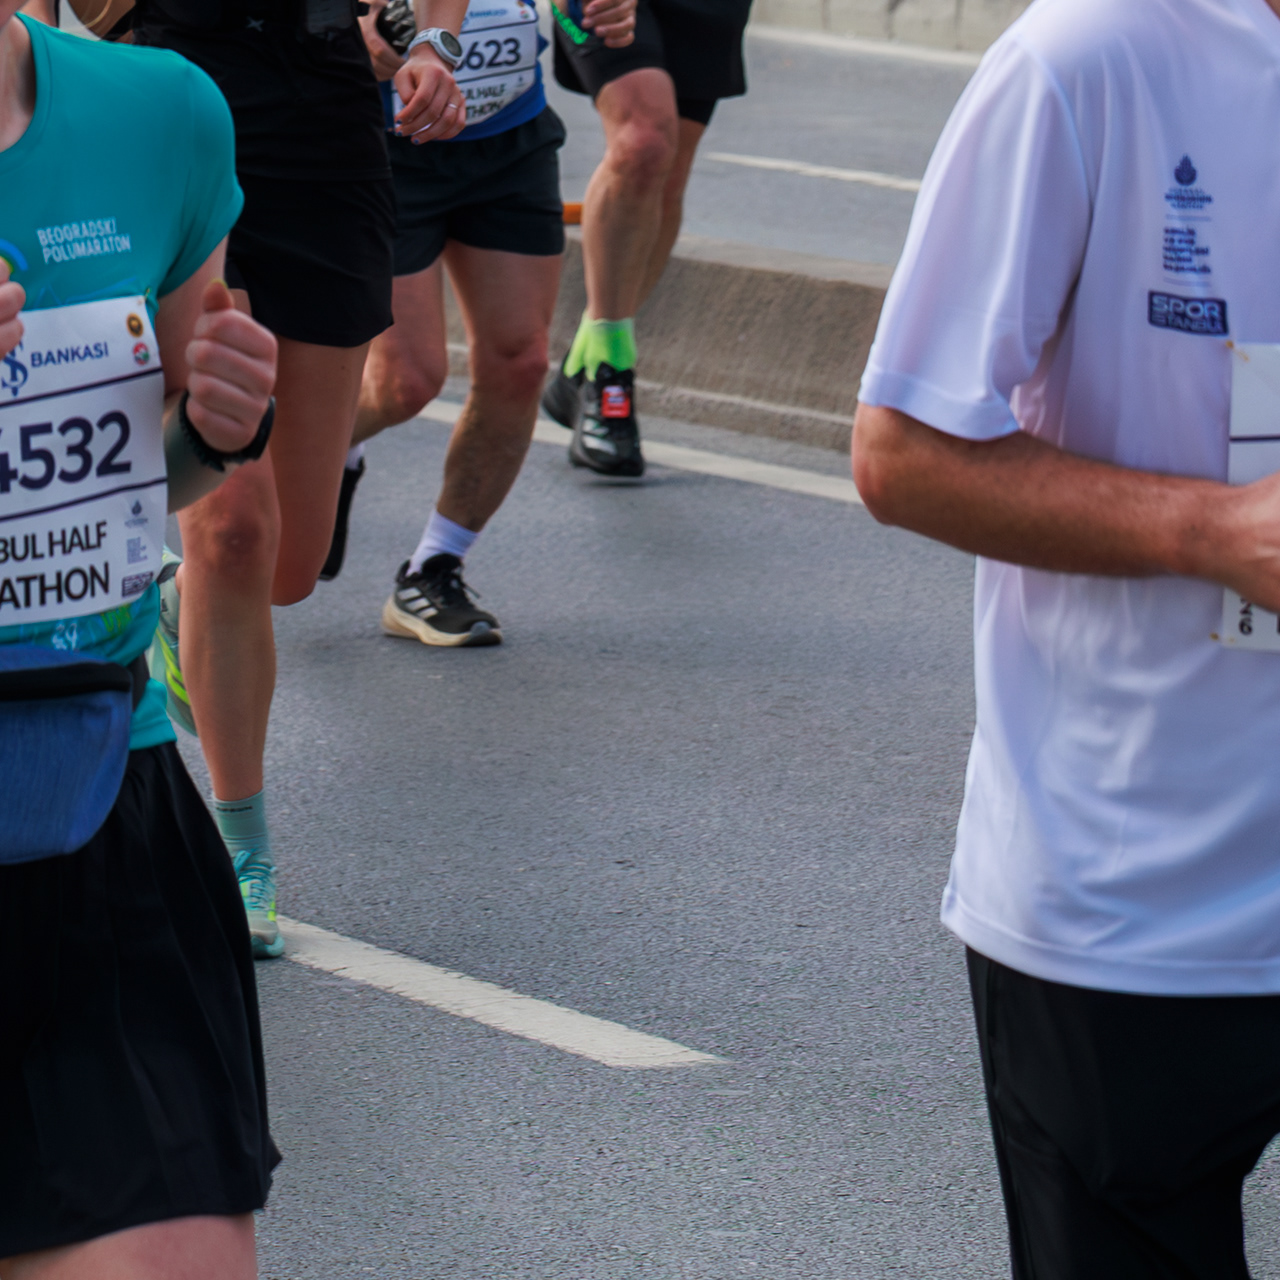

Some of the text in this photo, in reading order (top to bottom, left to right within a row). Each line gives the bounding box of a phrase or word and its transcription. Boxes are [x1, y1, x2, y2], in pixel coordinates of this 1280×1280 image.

[456, 38, 521, 72] 623
[1151, 294, 1221, 319] SPOR
[30, 341, 110, 369] BANKASI
[48, 521, 107, 558] HALF
[1238, 598, 1254, 636] 26
